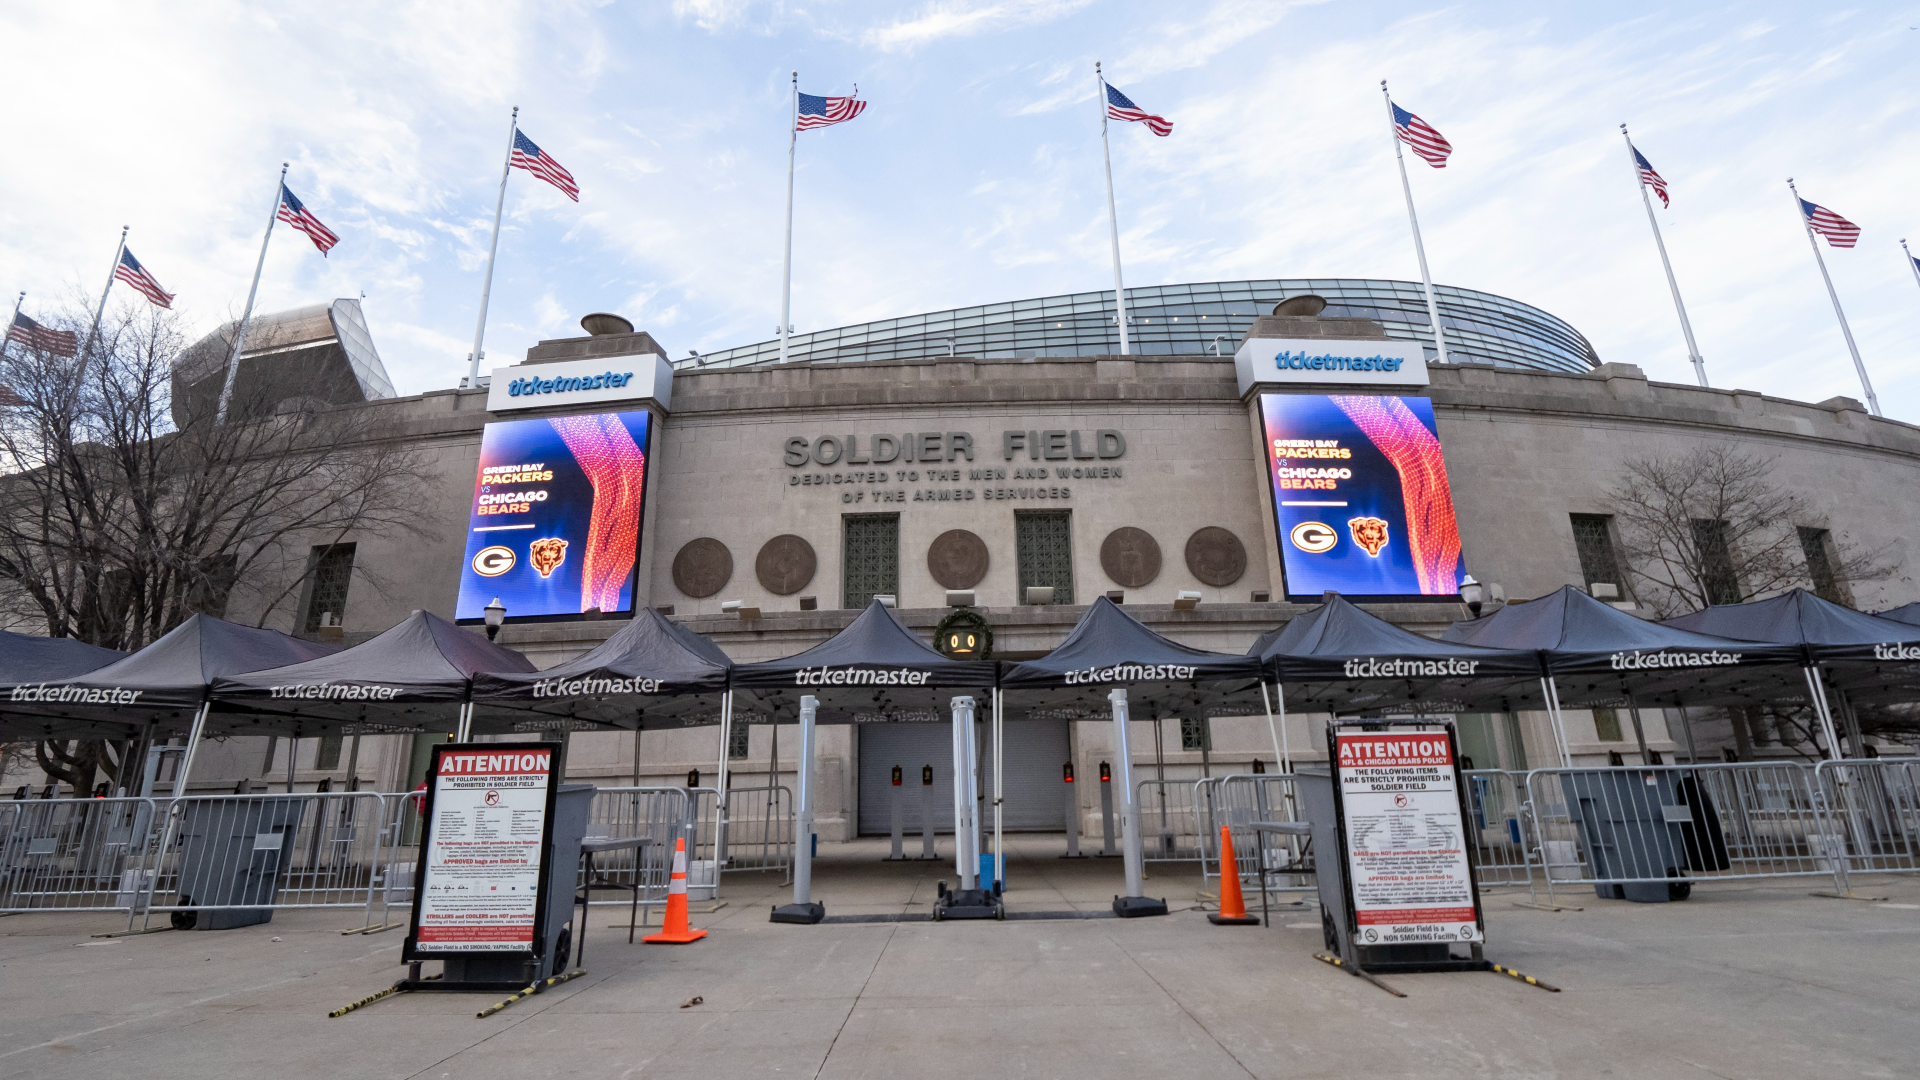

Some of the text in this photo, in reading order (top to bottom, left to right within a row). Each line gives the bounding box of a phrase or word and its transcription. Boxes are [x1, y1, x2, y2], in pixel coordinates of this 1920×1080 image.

[1275, 351, 1404, 371] ticketmaster
[508, 371, 633, 396] ticketmaster
[784, 429, 1126, 466] SOLDIER FIELD
[1273, 439, 1339, 448] GREEN BAY
[1275, 448, 1351, 459] PACKERS
[482, 463, 545, 475] GREEN BAY
[789, 466, 1123, 486] DEDICATED TO THE MEN AND WOMEN
[1278, 467, 1352, 479] CHICAGO
[481, 470, 553, 486] PACKERS
[1280, 479, 1337, 490] BEARS
[478, 490, 549, 505] CHICAGO
[480, 486, 491, 494] VS
[842, 486, 1071, 503] OF THE ARMED SERVICES
[477, 503, 531, 516] BEARS
[1874, 642, 1920, 660] ticke
[1344, 657, 1479, 679] ticketmaster
[1610, 650, 1742, 670] ticketmaster
[795, 665, 932, 686] ticketmaster
[1064, 662, 1198, 685] ticketmaster
[10, 682, 143, 704] ticketmaster
[270, 682, 403, 700] ticketmaster
[532, 675, 664, 698] ticketmaster
[1340, 741, 1447, 758] ATTENTION
[440, 754, 550, 773] ATTENTION
[1398, 757, 1422, 765] BEARS
[1354, 768, 1369, 776] THE
[1371, 783, 1403, 791] SOLDIER
[1434, 933, 1458, 941] Facility
